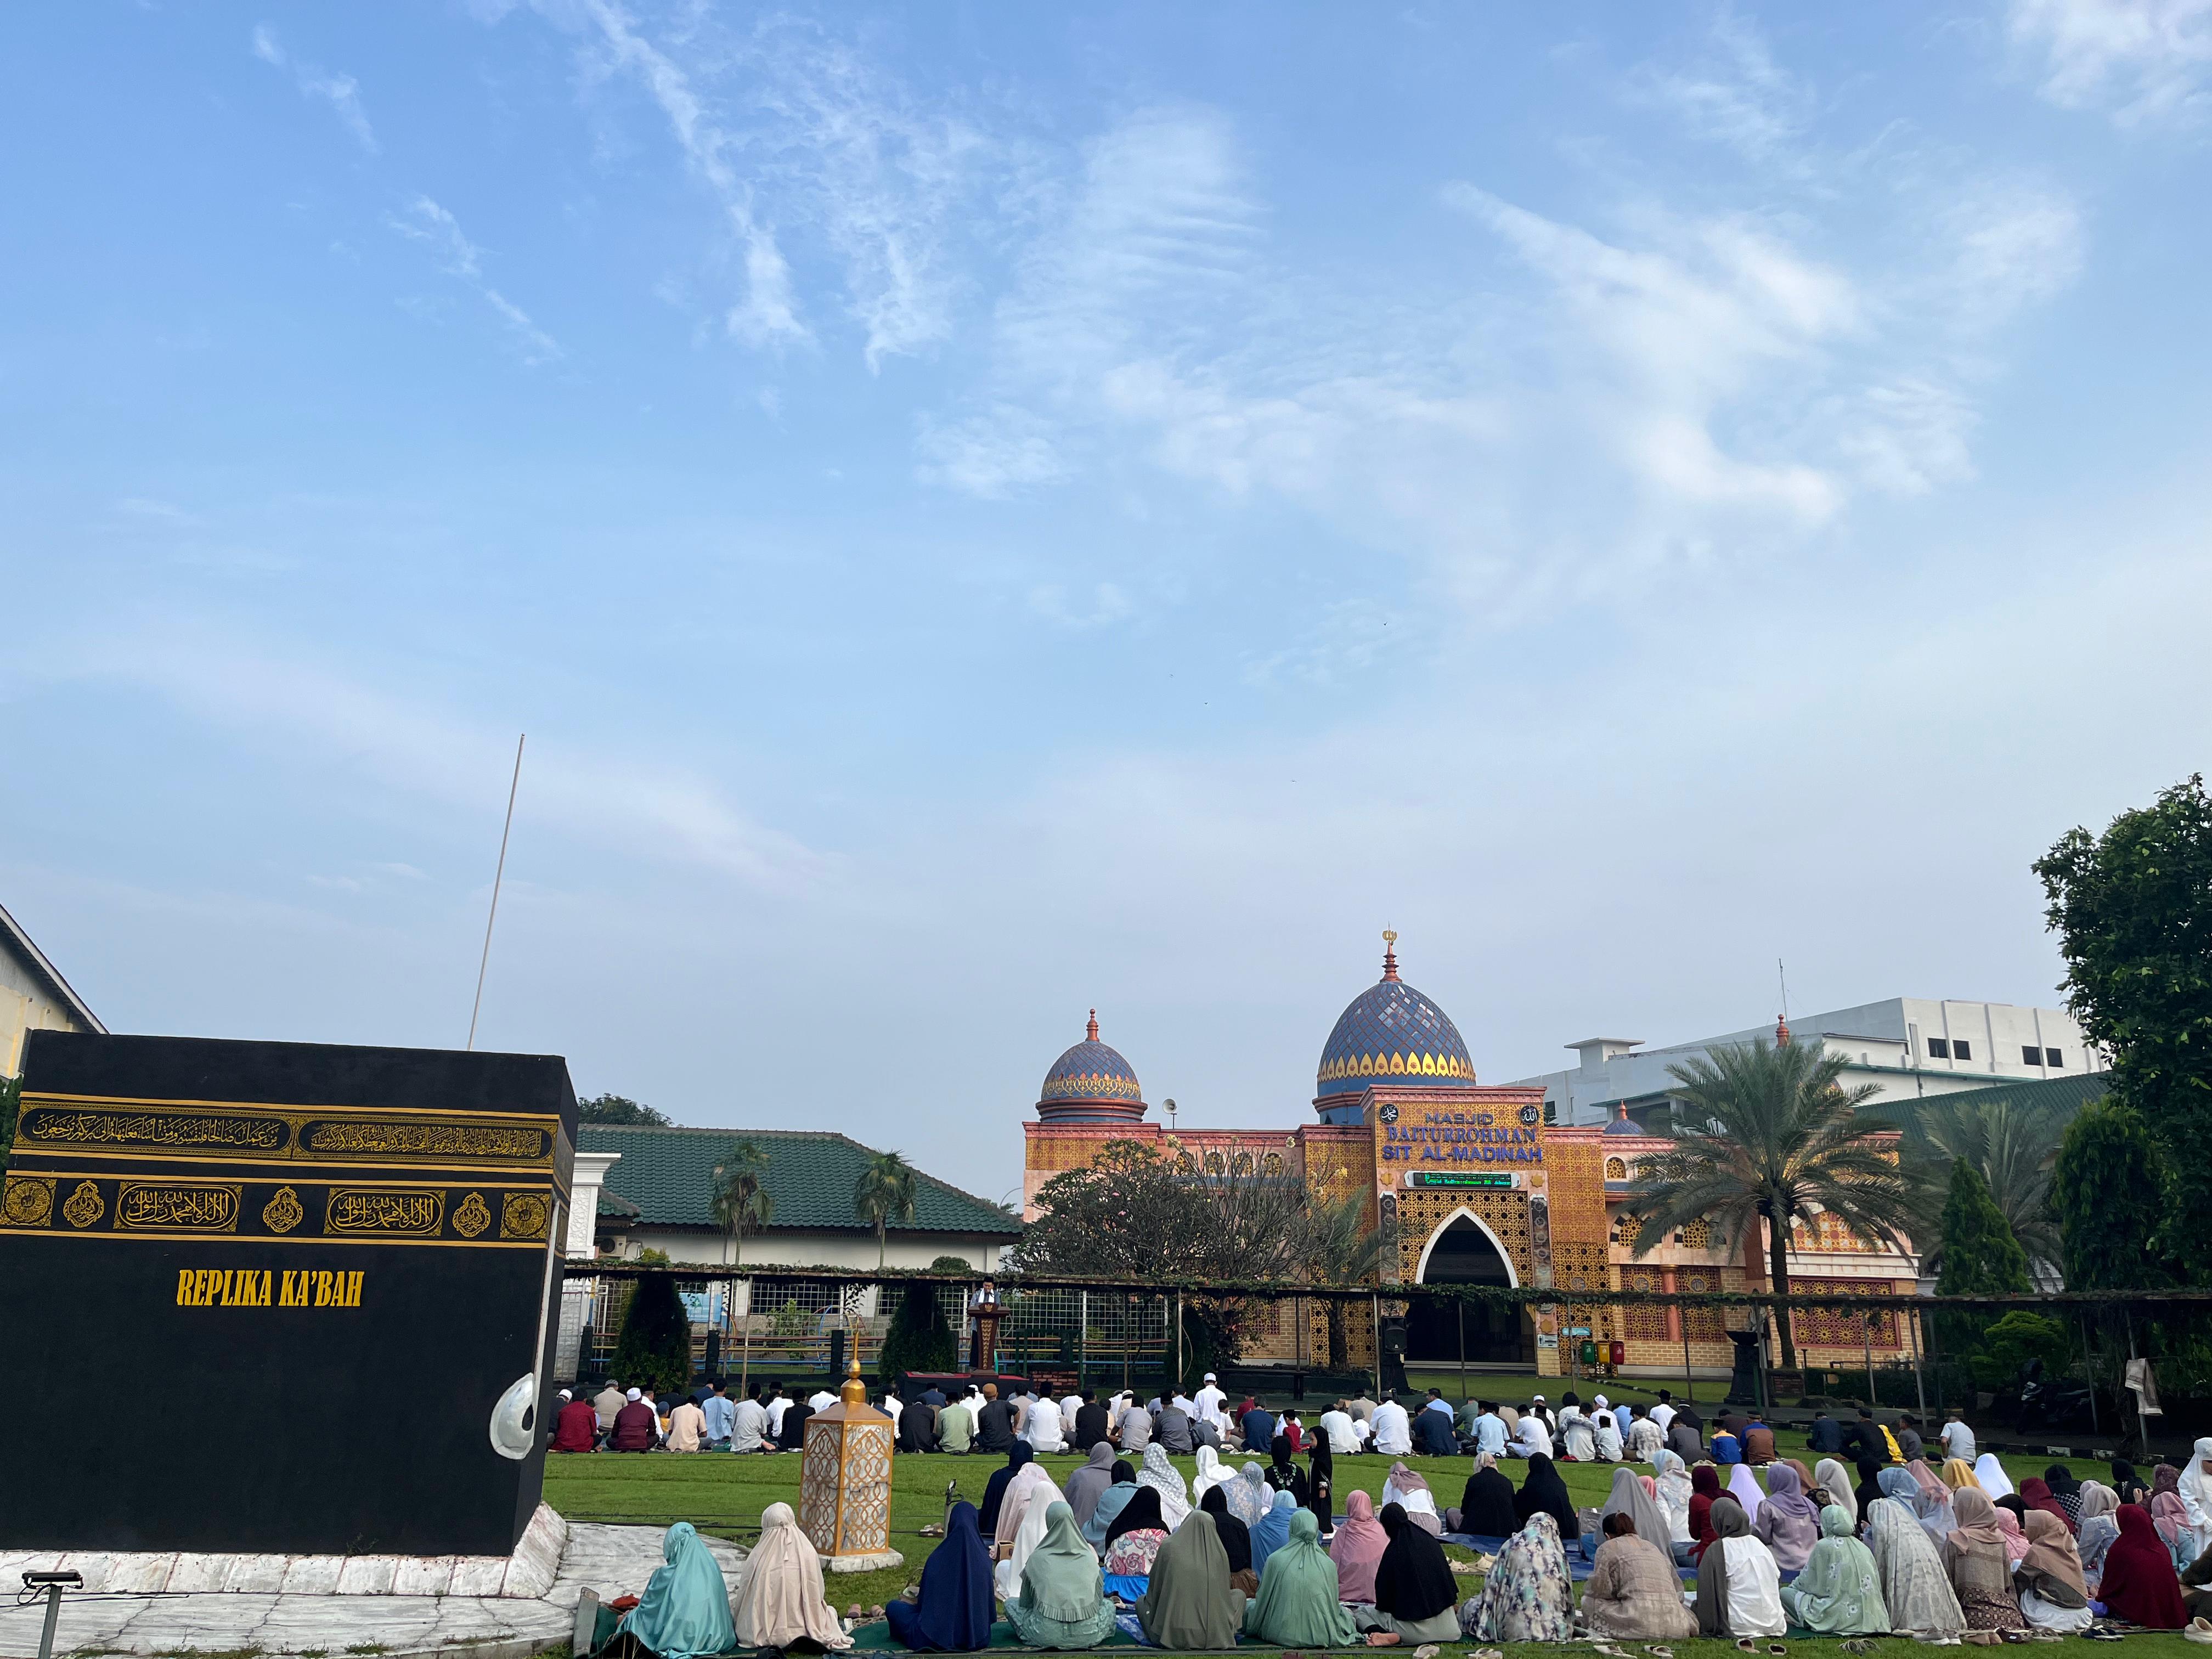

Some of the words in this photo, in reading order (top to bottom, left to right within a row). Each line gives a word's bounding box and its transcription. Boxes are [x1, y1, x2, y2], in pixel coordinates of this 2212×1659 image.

[1426, 1113, 1494, 1125] MASJID
[1387, 1126, 1536, 1143] BAITURROHMAN
[1382, 1146, 1412, 1160] SIT
[1422, 1146, 1542, 1161] AL-MADINAH
[176, 1269, 272, 1306] REPLIKA
[278, 1271, 365, 1307] KA'BAH
